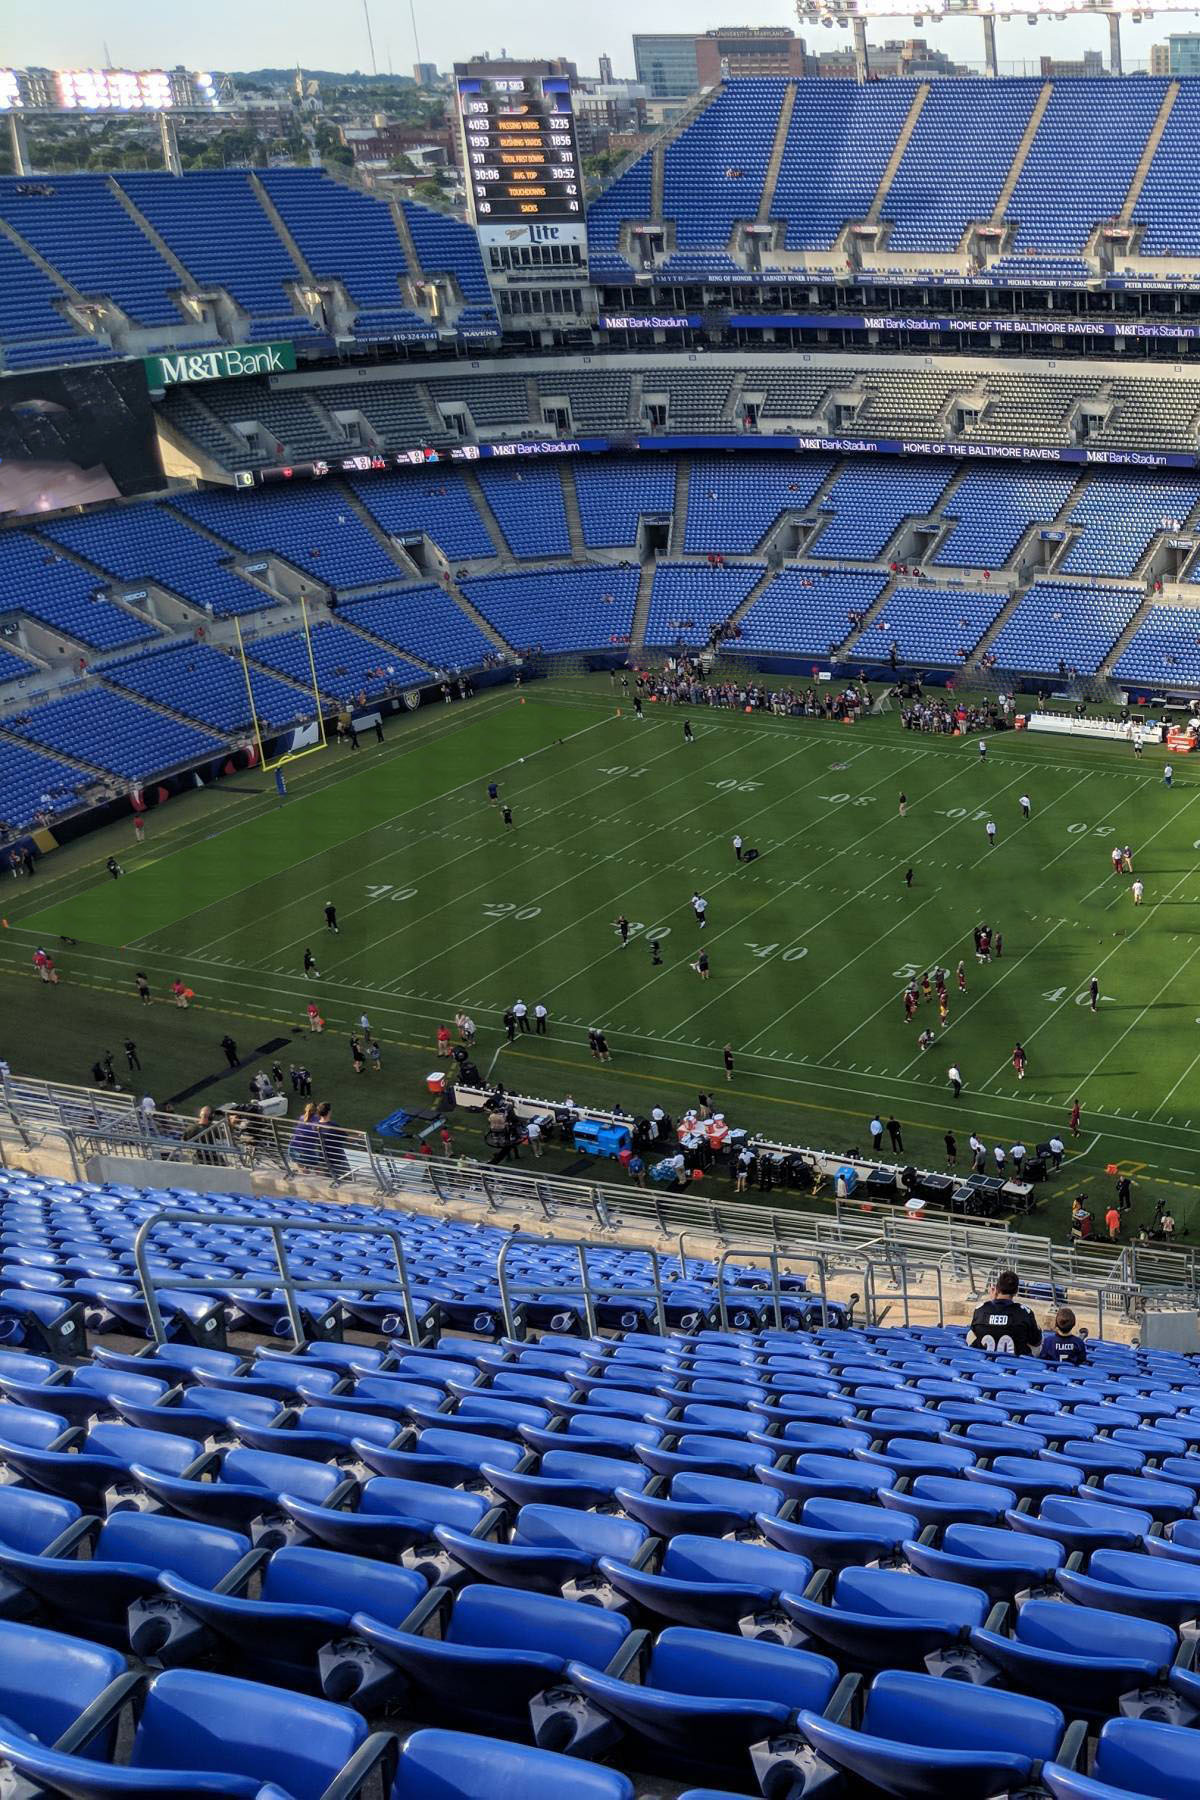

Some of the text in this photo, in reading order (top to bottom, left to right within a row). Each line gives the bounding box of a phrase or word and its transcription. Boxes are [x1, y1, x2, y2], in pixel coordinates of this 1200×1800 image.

[469, 103, 489, 113] 1953
[468, 119, 490, 130] 4053
[550, 119, 569, 129] 3235
[470, 136, 490, 147] 1953
[552, 136, 571, 146] 1856
[472, 152, 573, 164] 311 311
[475, 170, 500, 180] 30:06
[552, 169, 575, 179] 30:52
[477, 186, 487, 197] 51
[566, 185, 577, 195] 42
[479, 202, 491, 213] 48
[569, 200, 579, 211] 41
[528, 225, 560, 243] Lite
[972, 278, 994, 286] MODELL
[1007, 279, 1031, 287] MICHAEL
[1125, 282, 1142, 290] PETER
[1143, 282, 1172, 290] BOULWARE
[606, 317, 688, 328] M&T Bank Stadium
[864, 318, 940, 330] M&T Bank Stadium
[949, 320, 1104, 334] HOME OF THE BALTIMORE RAVENS
[393, 331, 438, 340] 410-324-6141
[462, 329, 498, 337] RAVENS
[1115, 324, 1194, 337] M&T Bank Stadium
[160, 346, 285, 384] M&T Bank
[493, 442, 580, 456] M&T Bank Stadium
[799, 438, 877, 451] M&T Bank Stadium
[903, 443, 1060, 459] HOME OF THE BALTIMORE RAVENS
[1086, 451, 1167, 465] M&T Bank Stadium
[482, 903, 543, 920] 20
[989, 1314, 1008, 1325] REED
